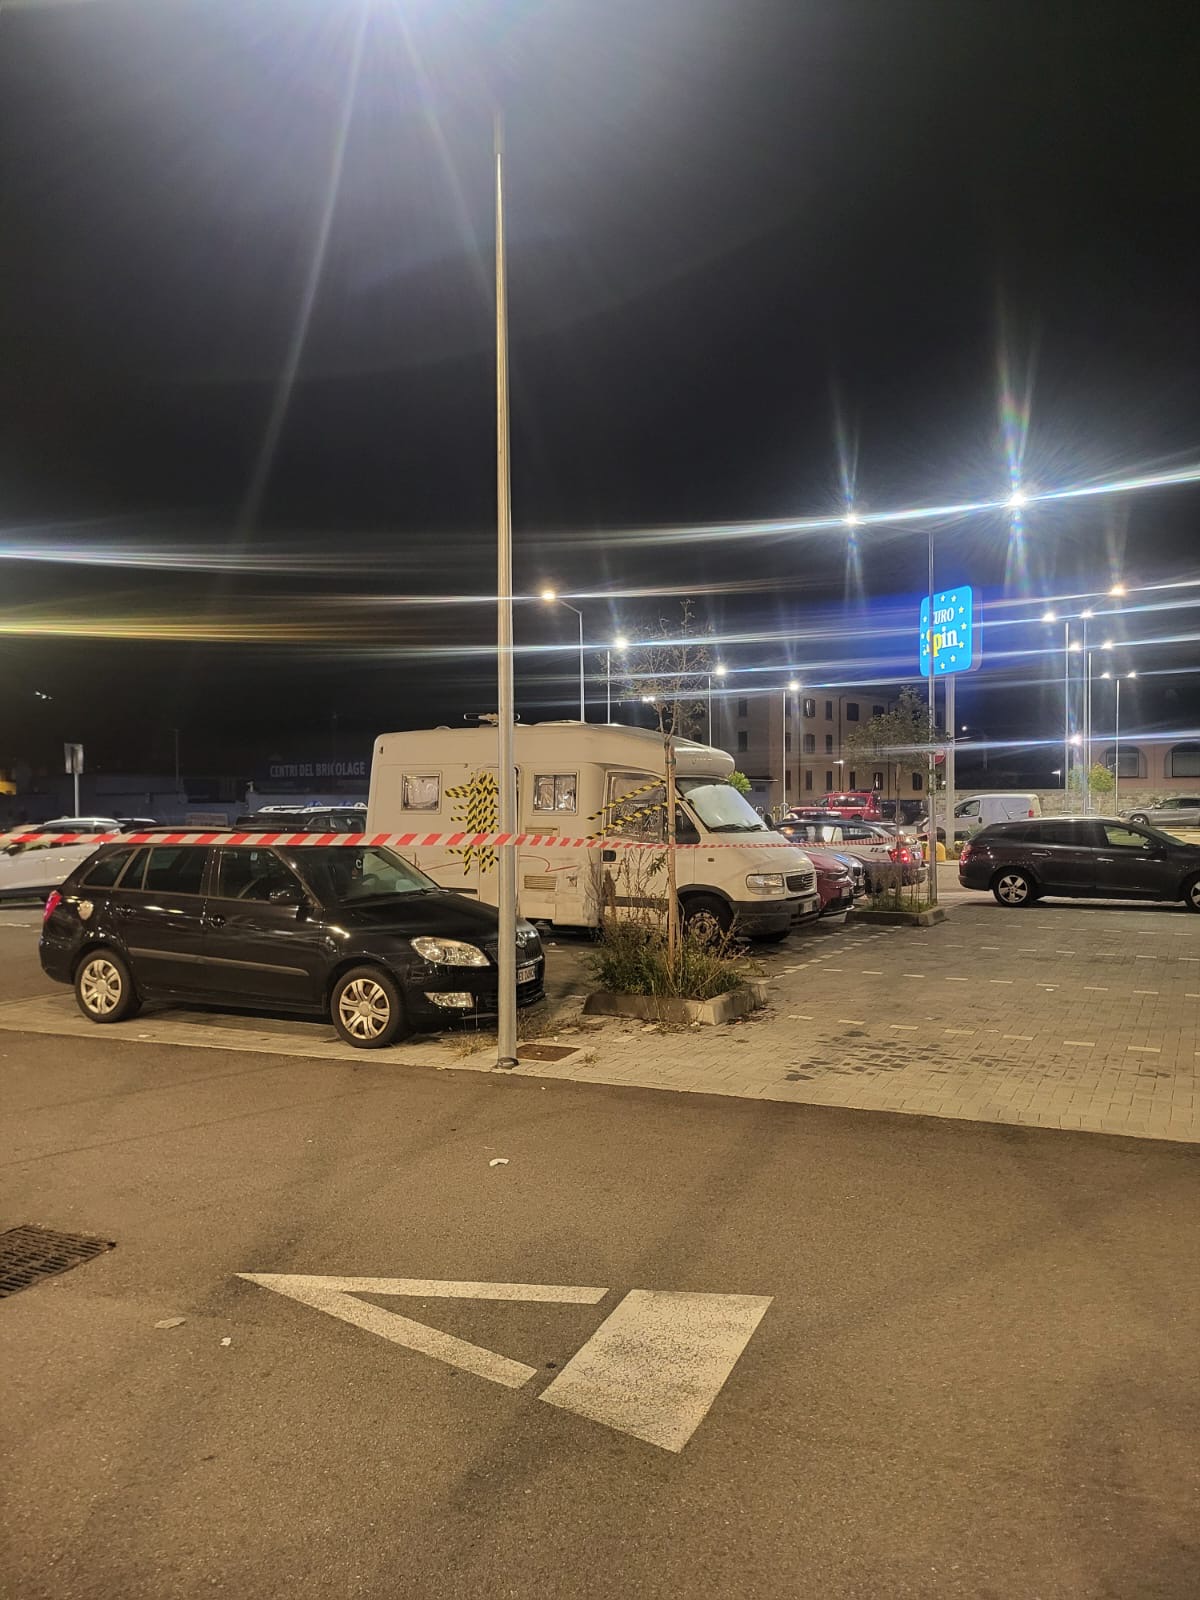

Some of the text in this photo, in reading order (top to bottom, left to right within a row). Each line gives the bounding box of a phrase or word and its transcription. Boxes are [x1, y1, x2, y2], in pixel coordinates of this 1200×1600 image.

[270, 761, 365, 778] CENTRI DEL BRICOLAGE
